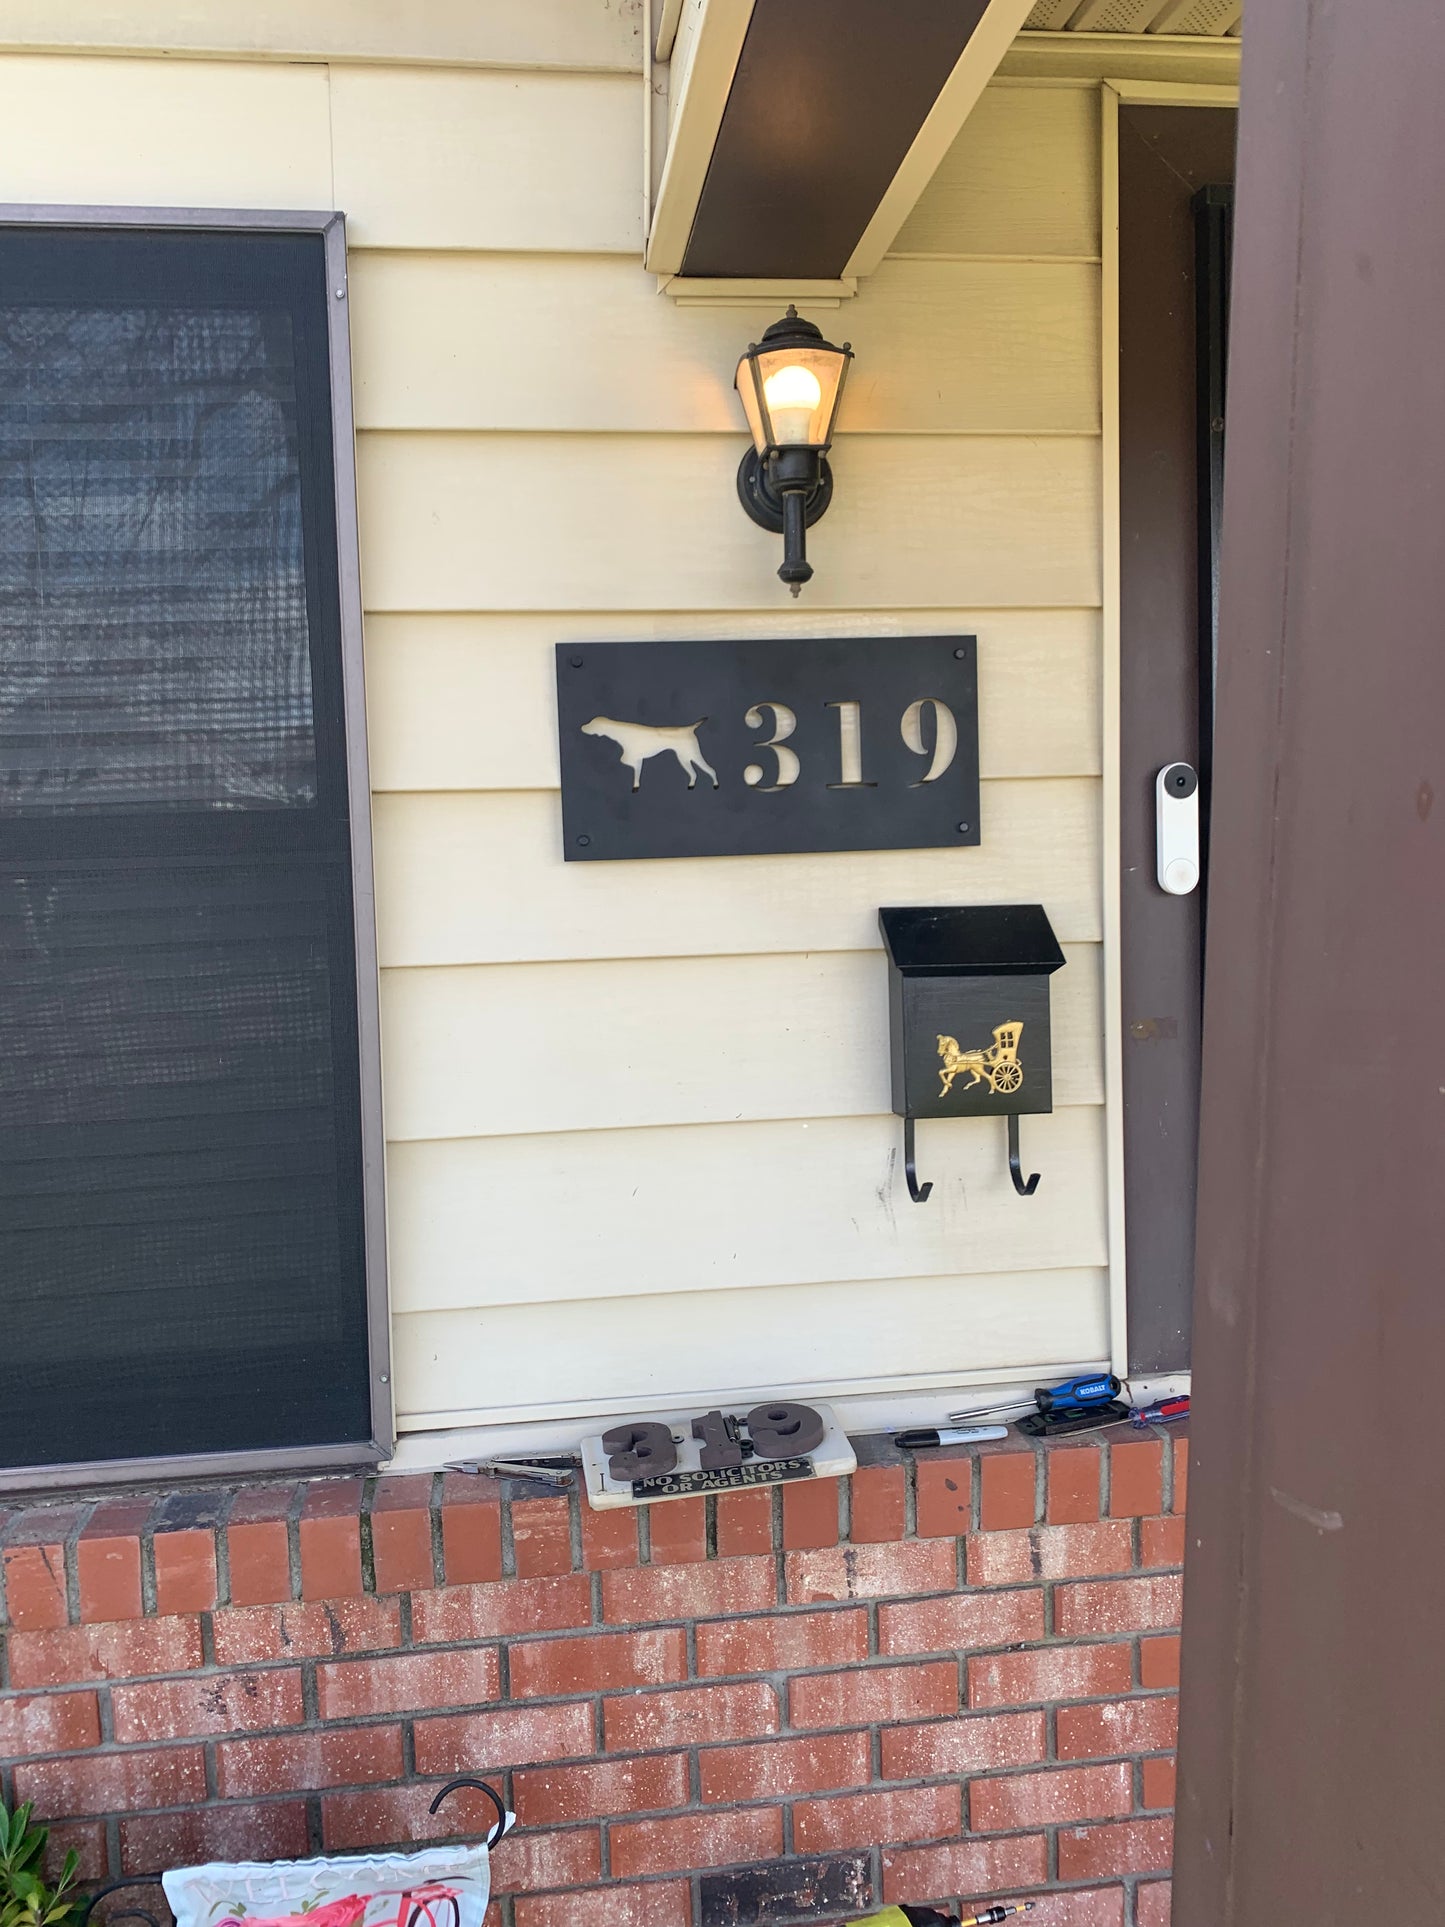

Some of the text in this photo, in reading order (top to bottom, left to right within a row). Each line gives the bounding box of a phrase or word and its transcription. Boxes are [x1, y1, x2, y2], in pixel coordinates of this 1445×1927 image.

[744, 698, 958, 793] 319
[1080, 1384, 1105, 1395] KOBALT
[602, 1402, 824, 1481] 319
[643, 1460, 800, 1488] NO SOLICITORS
[662, 1470, 783, 1493] OR AGENTS
